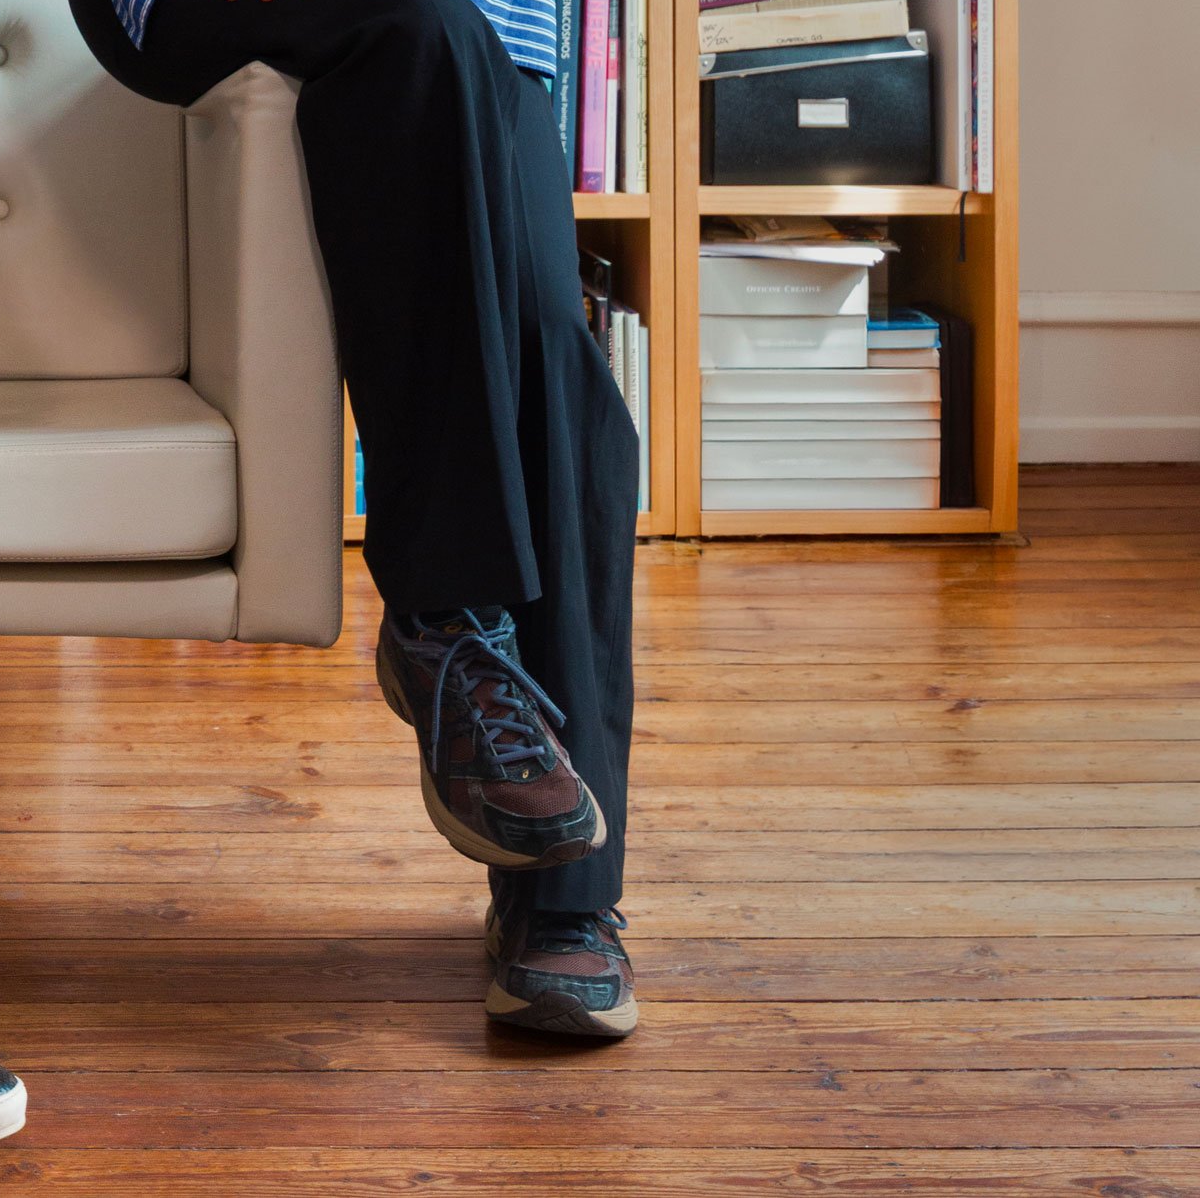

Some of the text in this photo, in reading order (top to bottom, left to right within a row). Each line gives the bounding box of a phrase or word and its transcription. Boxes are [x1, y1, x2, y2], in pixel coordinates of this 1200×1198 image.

[561, 71, 570, 83] The
[560, 84, 569, 102] Royal
[558, 103, 568, 132] Paintings
[559, 132, 568, 140] of
